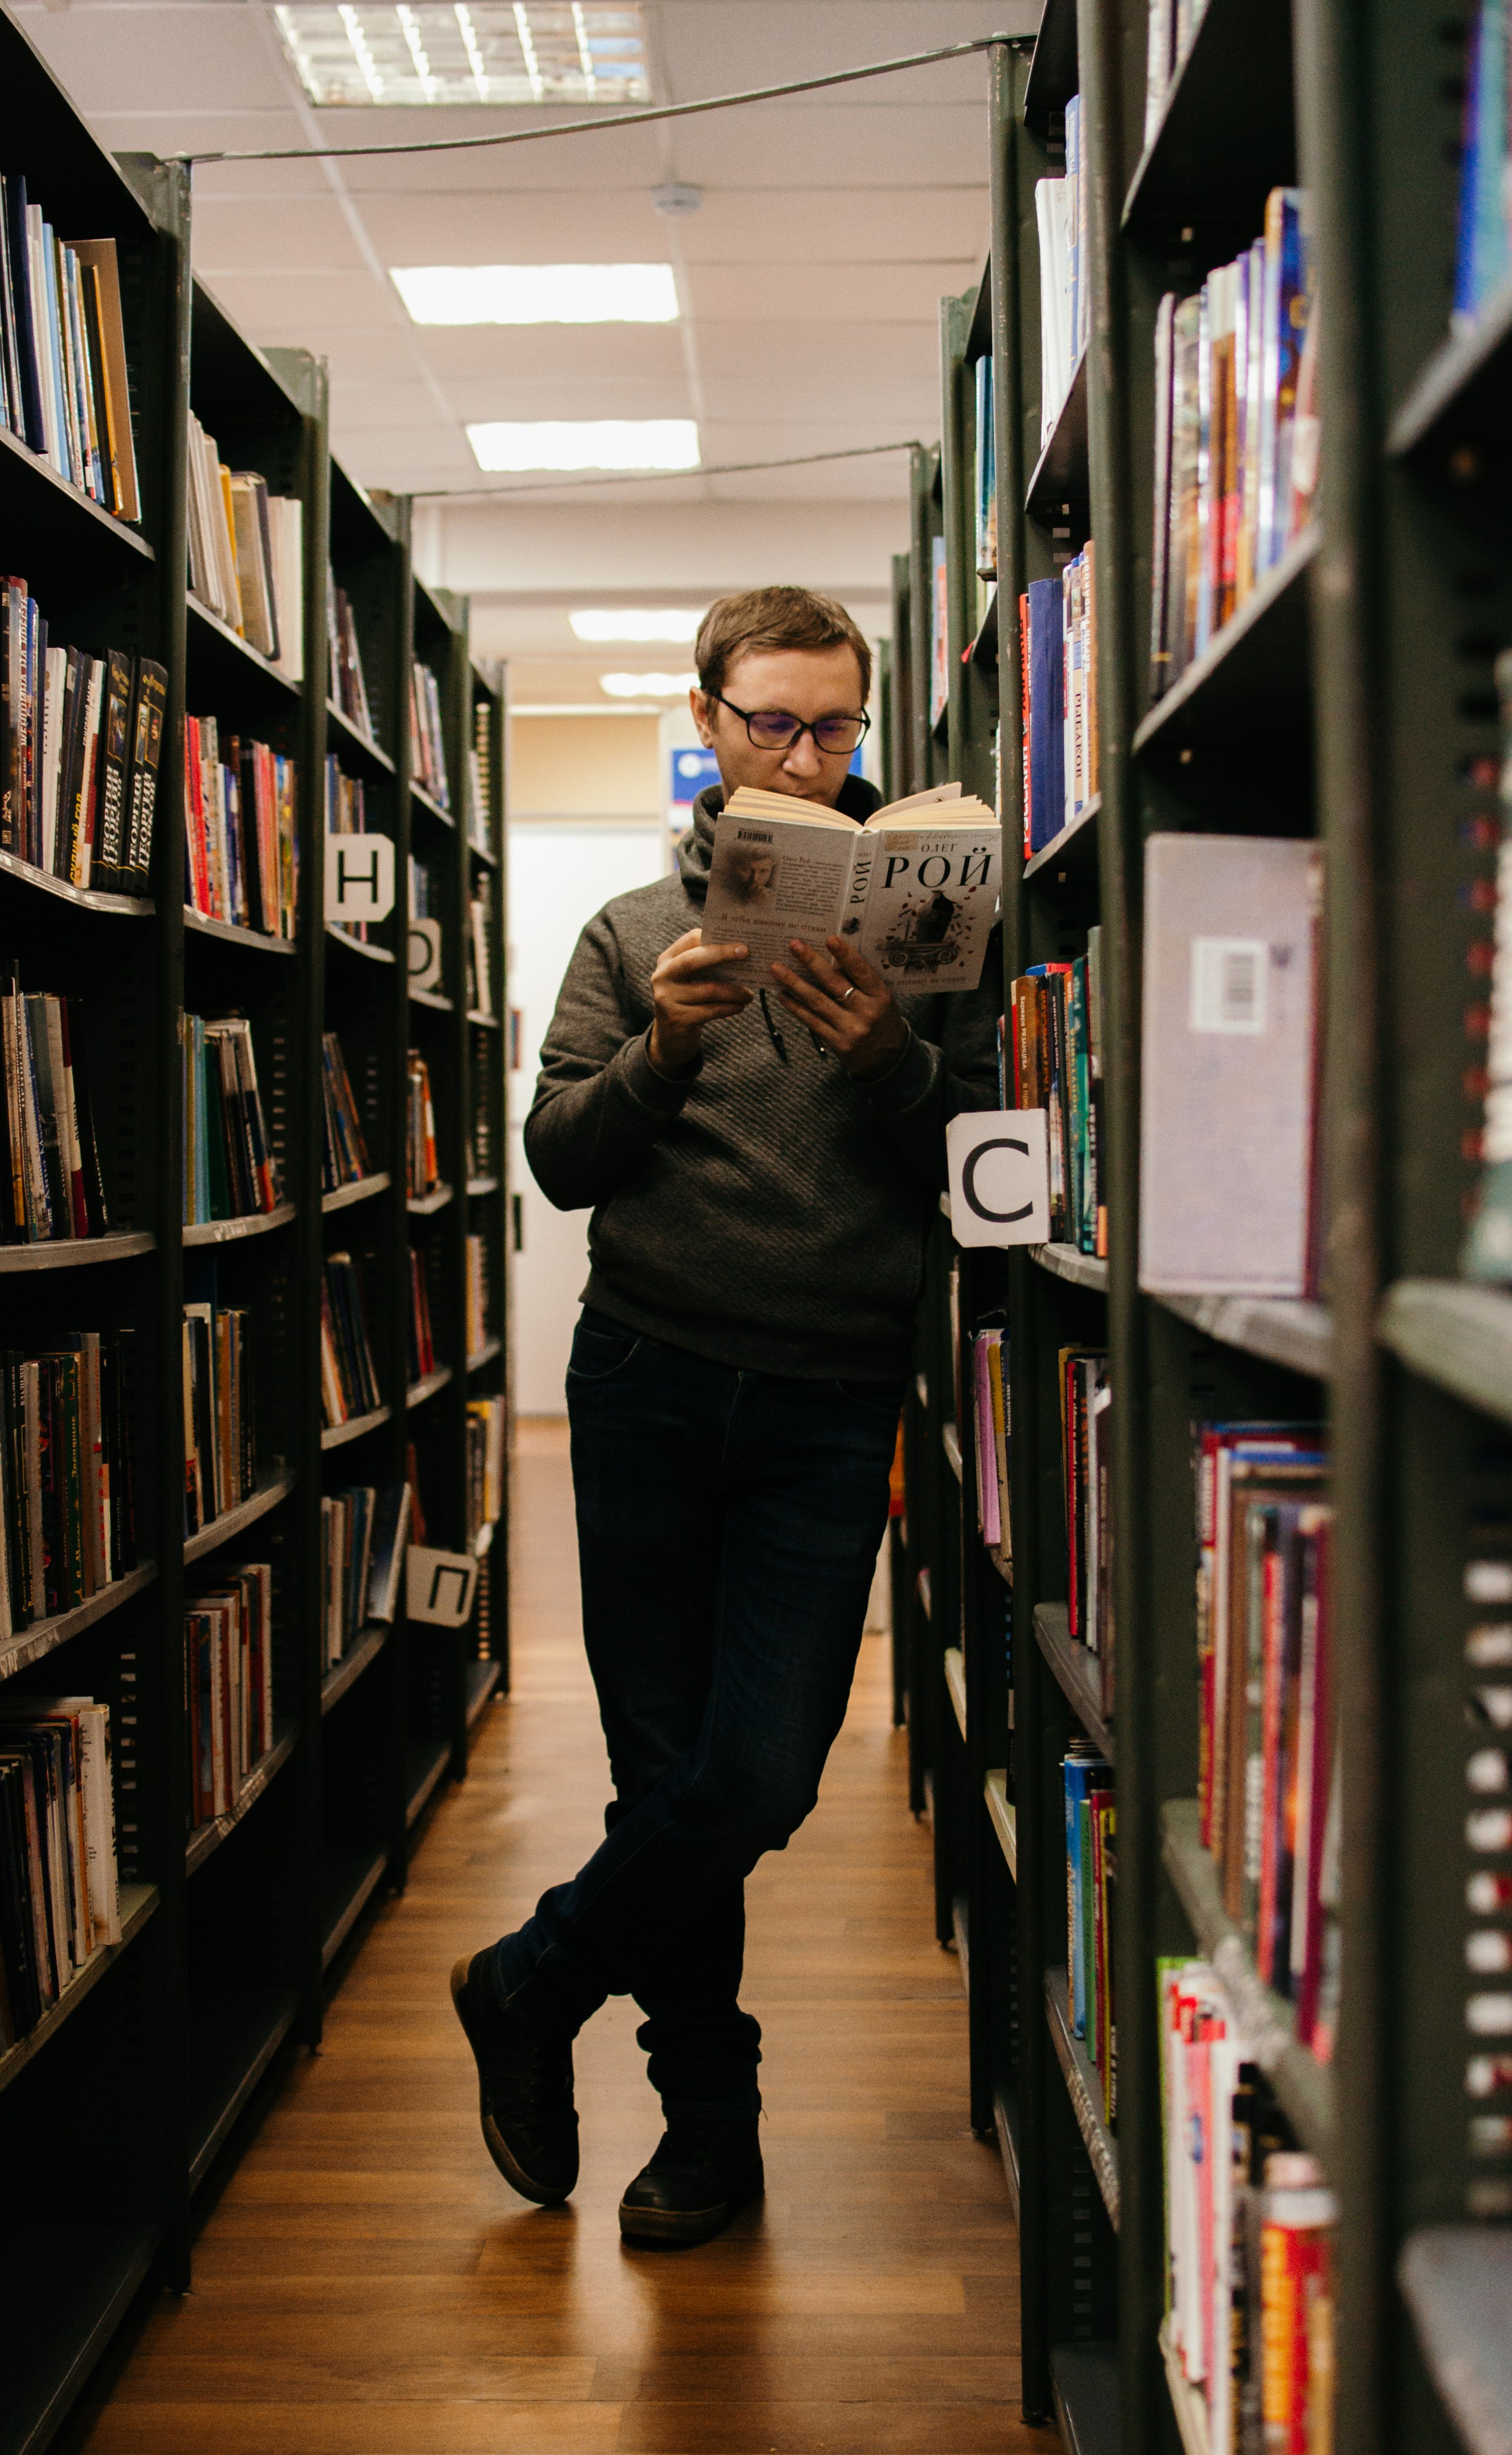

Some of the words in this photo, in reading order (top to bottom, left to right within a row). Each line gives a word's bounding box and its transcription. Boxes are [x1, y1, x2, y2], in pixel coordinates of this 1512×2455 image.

[880, 846, 995, 888] РОЙ
[921, 843, 958, 853] ОЛЕГ
[337, 850, 378, 904] Н
[850, 861, 871, 903] РОЙ
[961, 1138, 1034, 1223] С
[428, 1564, 470, 1615] П
